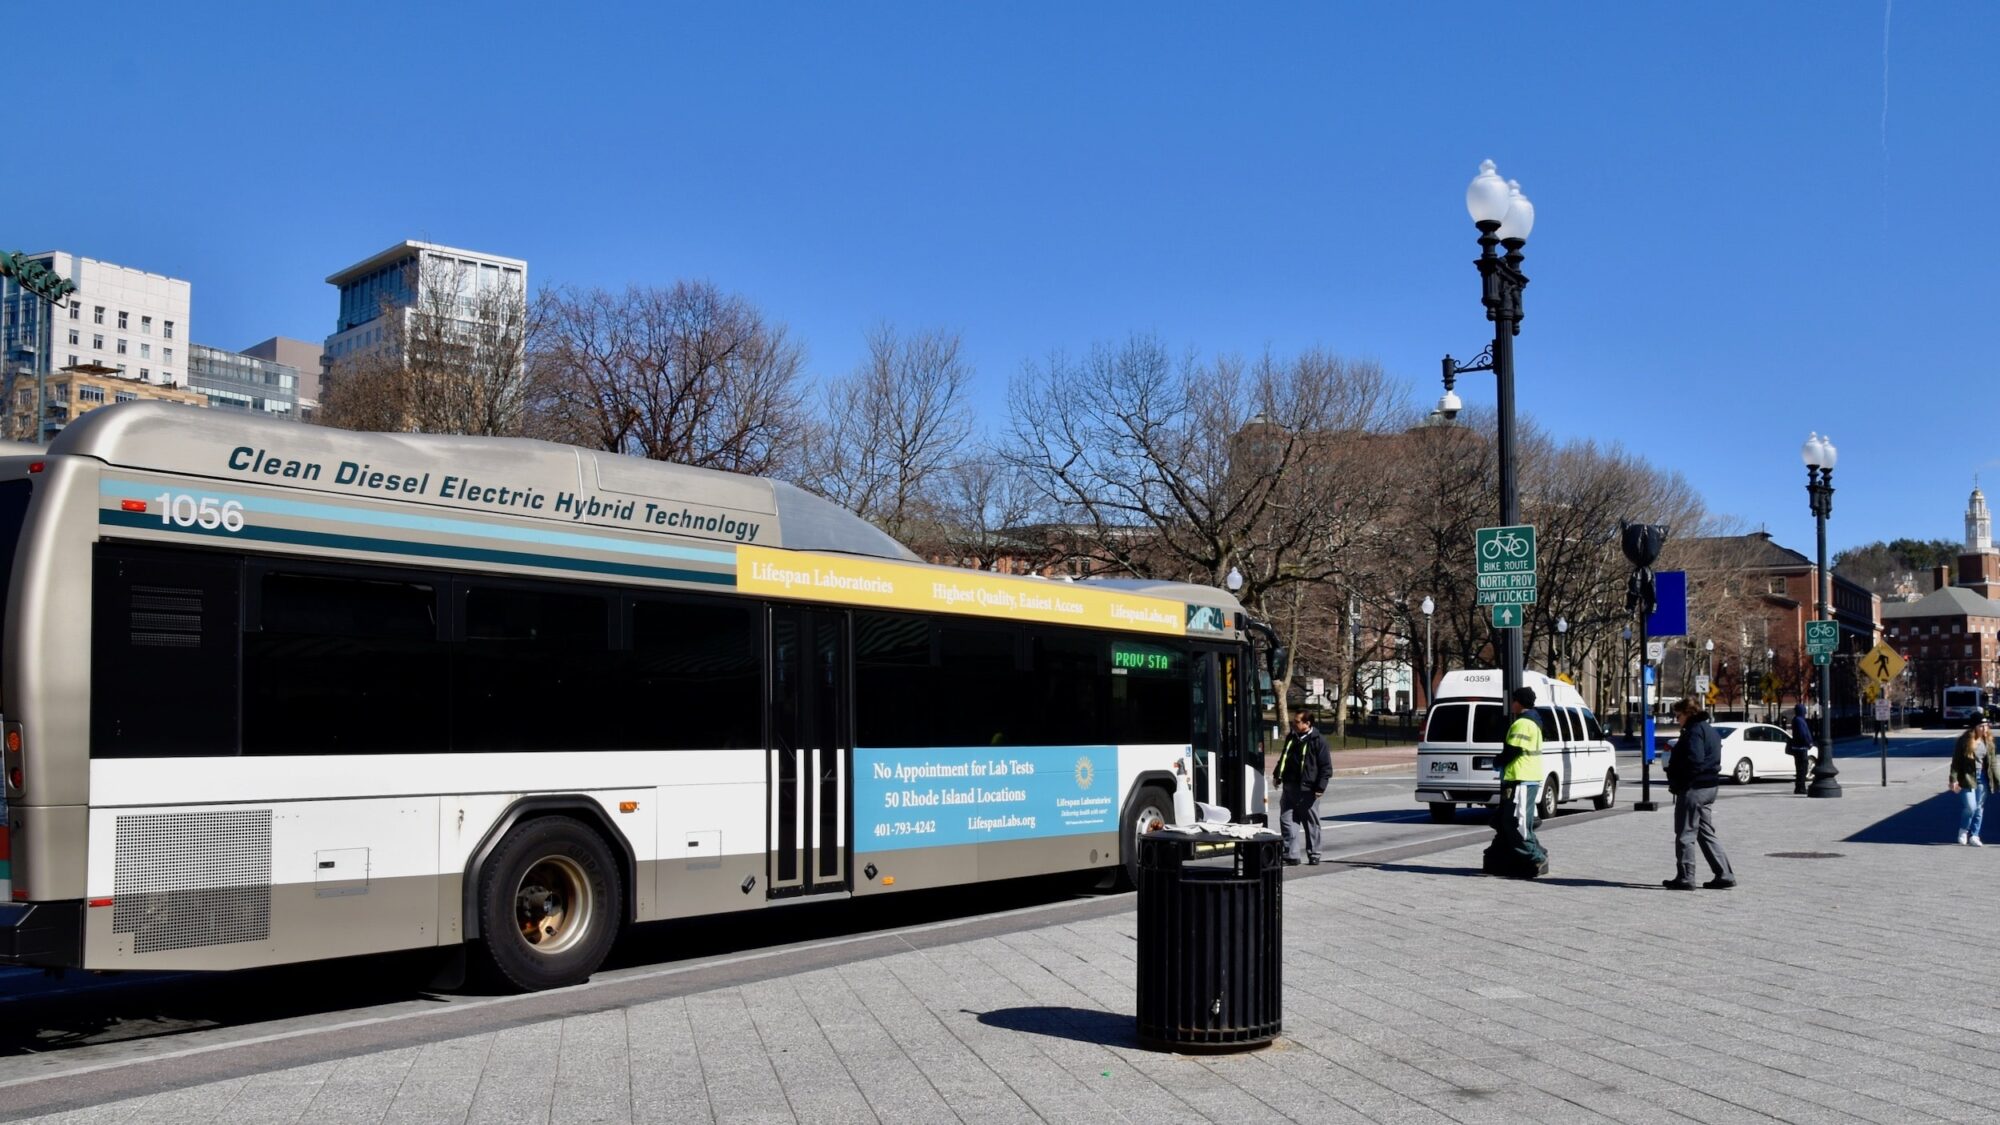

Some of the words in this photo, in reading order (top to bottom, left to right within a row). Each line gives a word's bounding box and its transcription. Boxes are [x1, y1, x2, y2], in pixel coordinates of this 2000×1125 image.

[228, 446, 321, 480] Clean
[334, 461, 429, 494] Diesel
[439, 475, 544, 509] Electric
[554, 491, 635, 520] Hybrid
[645, 503, 760, 541] Technology
[156, 492, 244, 532] 1056
[1484, 561, 1501, 571] BIKE
[1504, 560, 1528, 570] ROUTE
[752, 561, 810, 588] Lifespan
[814, 568, 893, 593] Laboratories
[1480, 576, 1507, 588] NORTH
[1511, 575, 1533, 586] PROV
[932, 583, 975, 605] Highest
[976, 588, 1017, 610] Quality,
[1019, 592, 1051, 610] Easiest
[1055, 598, 1084, 614] Access
[1479, 590, 1534, 603] PAWTUCKET
[1110, 603, 1178, 629] LifespanLabs.org
[1115, 652, 1144, 667] PROV
[1148, 654, 1168, 669] STA
[1464, 675, 1490, 683] 40359
[873, 762, 892, 779] No
[894, 761, 968, 783] Appointment
[971, 761, 986, 776] for
[989, 760, 1008, 776] Lab
[1010, 759, 1034, 775] Tests
[884, 791, 899, 808] 50
[902, 789, 939, 807] Rhode
[941, 787, 975, 805] Island
[977, 786, 1026, 803] Locations
[873, 820, 935, 837] 401-793-4242
[968, 814, 1036, 832] LifespanLabs.org
